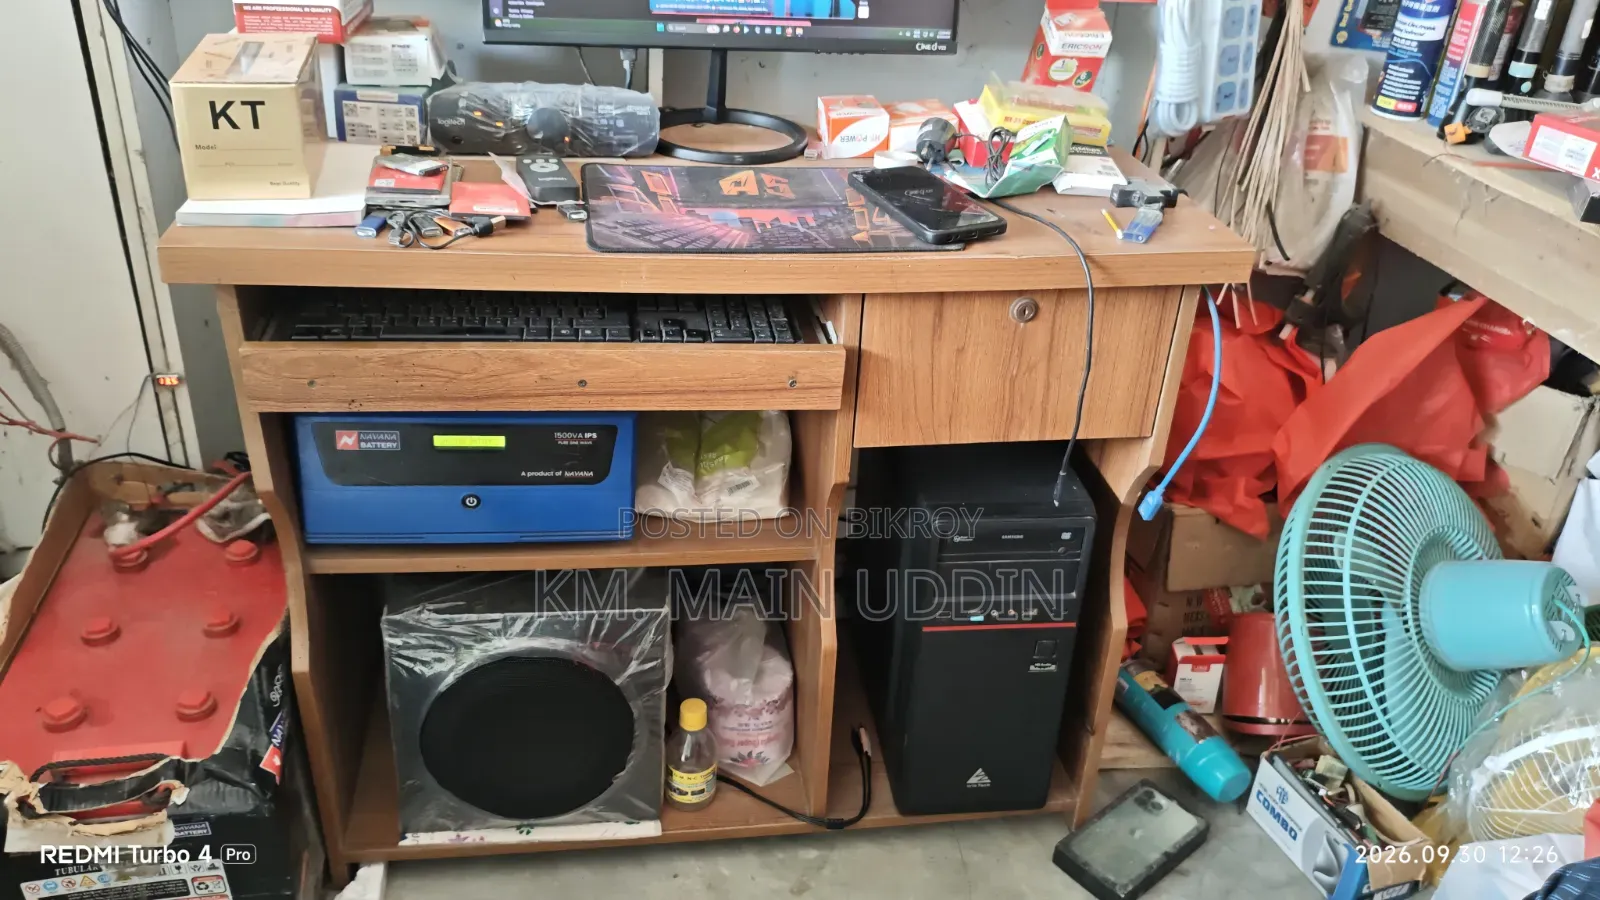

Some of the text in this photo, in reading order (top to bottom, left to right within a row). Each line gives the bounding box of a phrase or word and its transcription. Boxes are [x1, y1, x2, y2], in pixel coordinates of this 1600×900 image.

[208, 100, 266, 130] KT
[437, 117, 466, 127] logitech
[527, 470, 554, 478] product
[1256, 789, 1298, 841] COMBO
